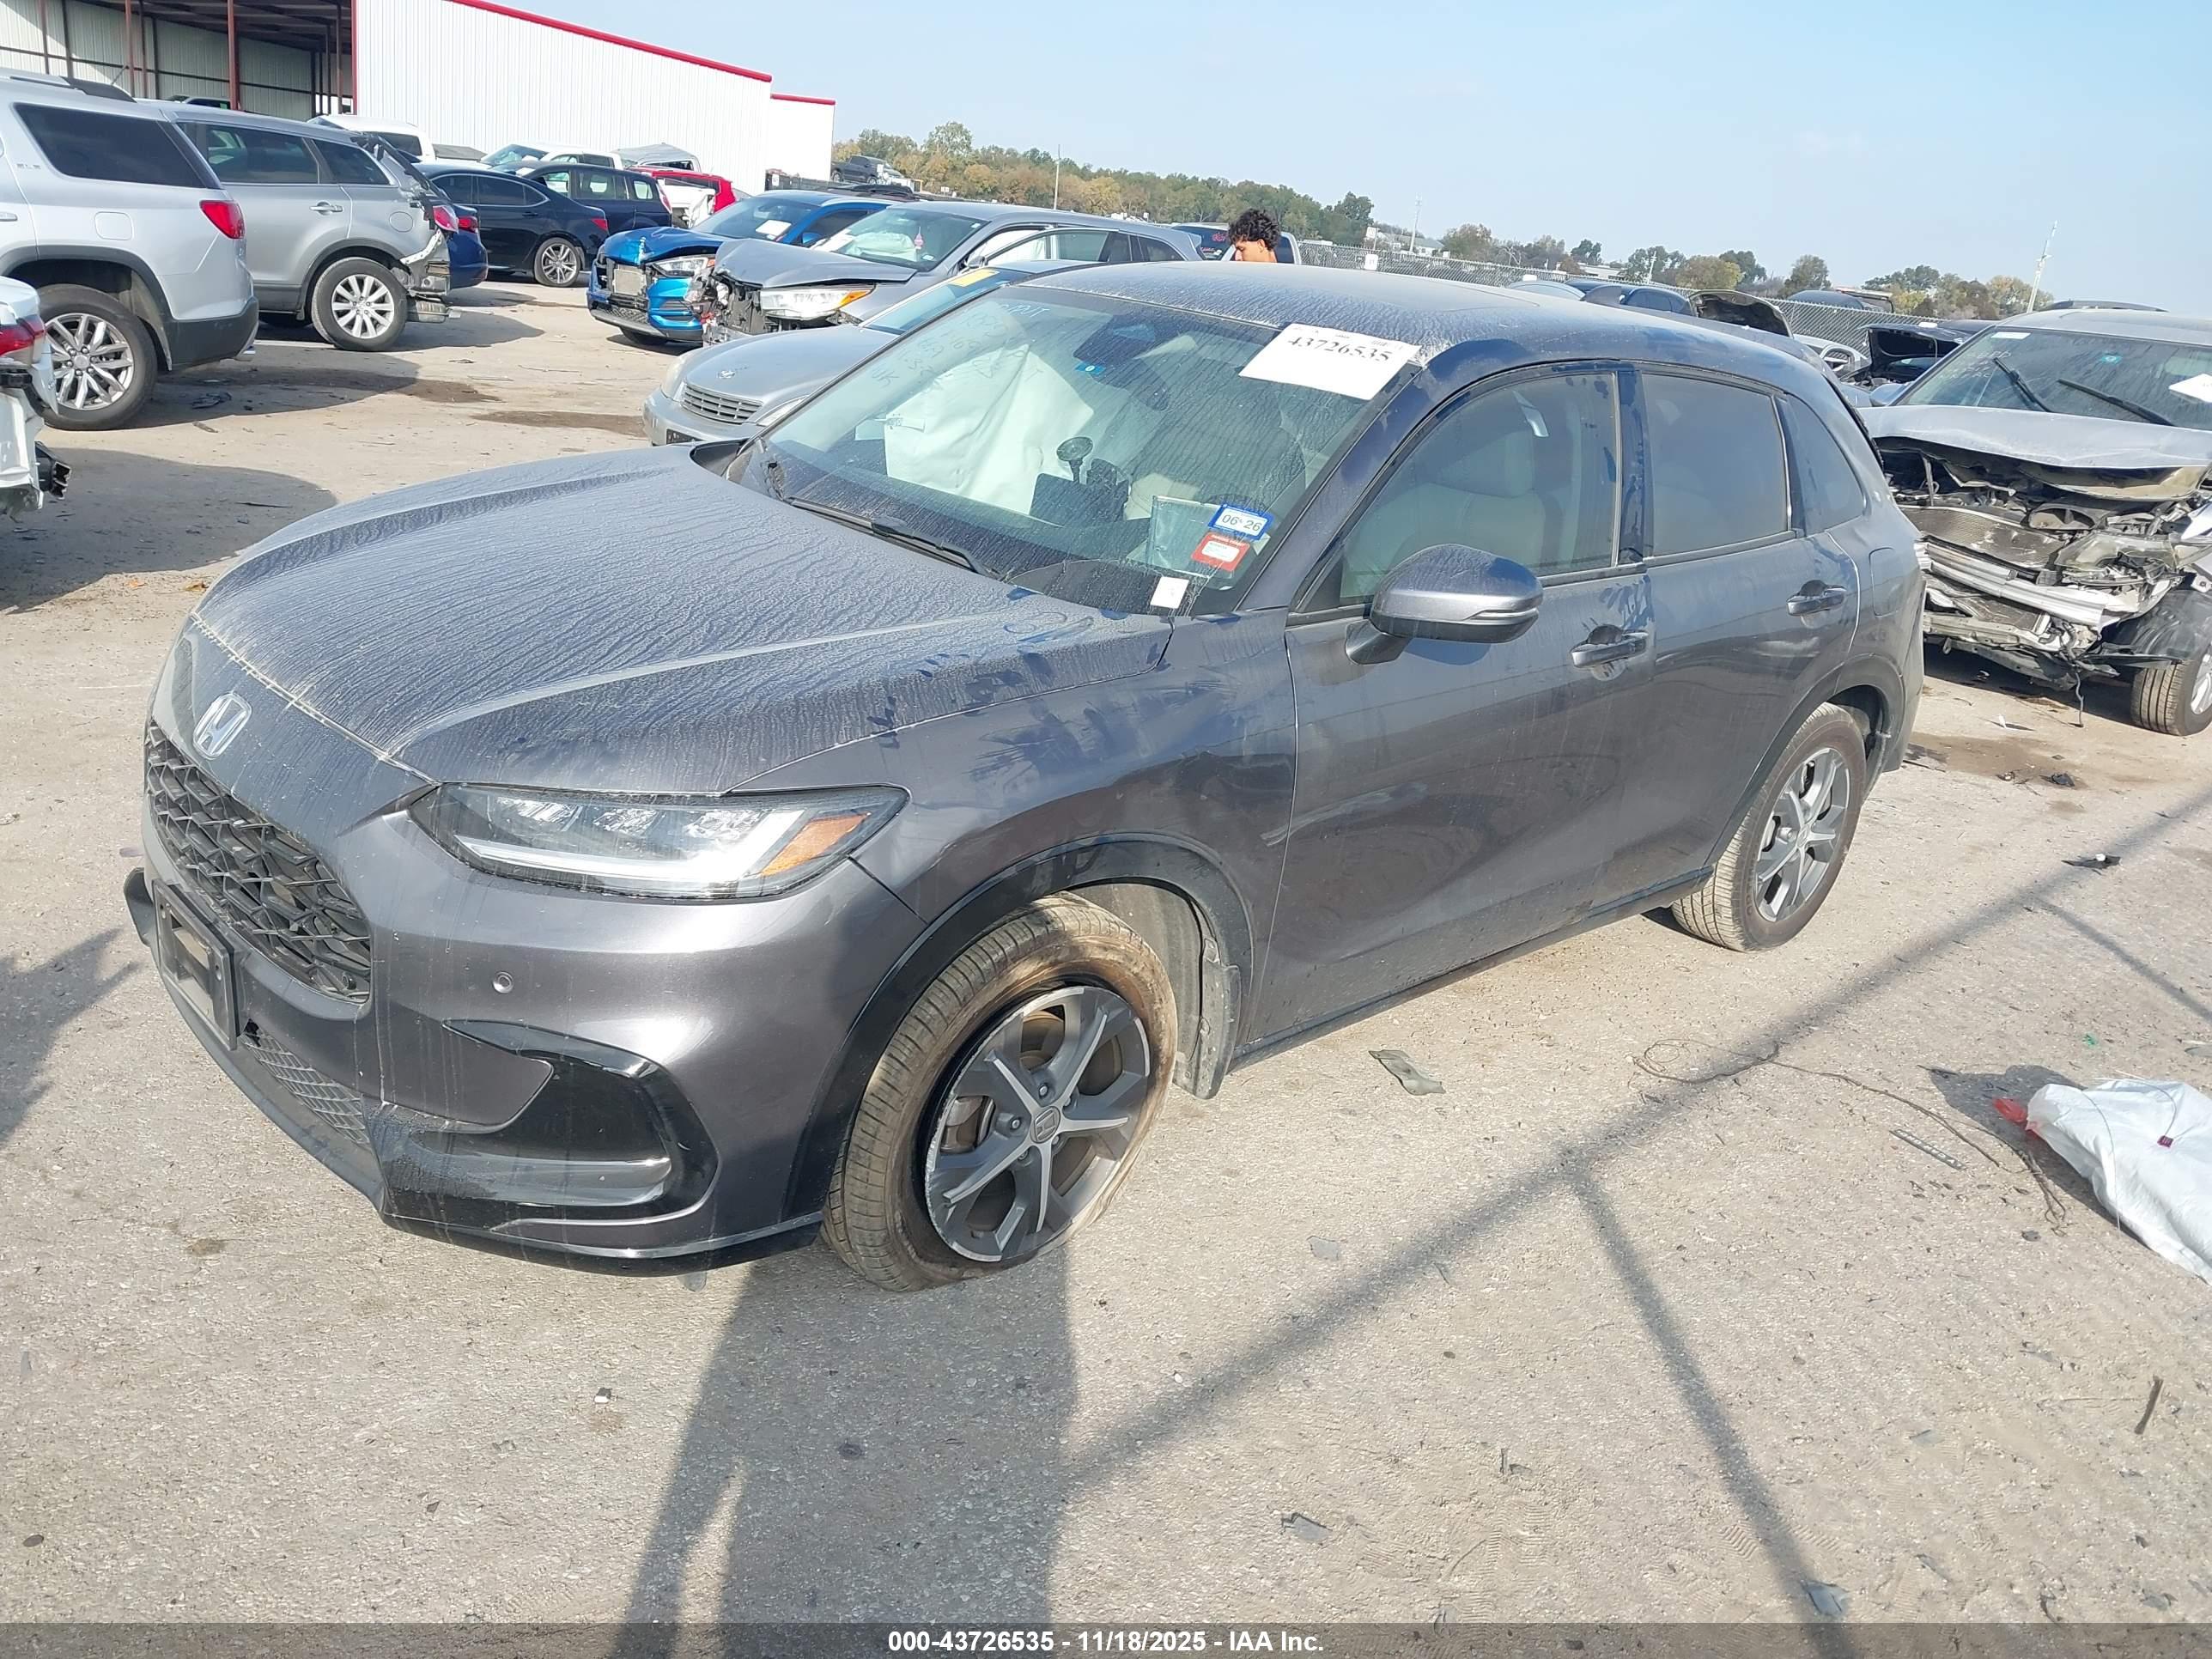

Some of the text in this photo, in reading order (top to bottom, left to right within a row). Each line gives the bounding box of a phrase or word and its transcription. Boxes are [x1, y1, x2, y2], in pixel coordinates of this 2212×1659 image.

[1287, 336, 1393, 362] 43726535
[1222, 514, 1262, 532] 06 26
